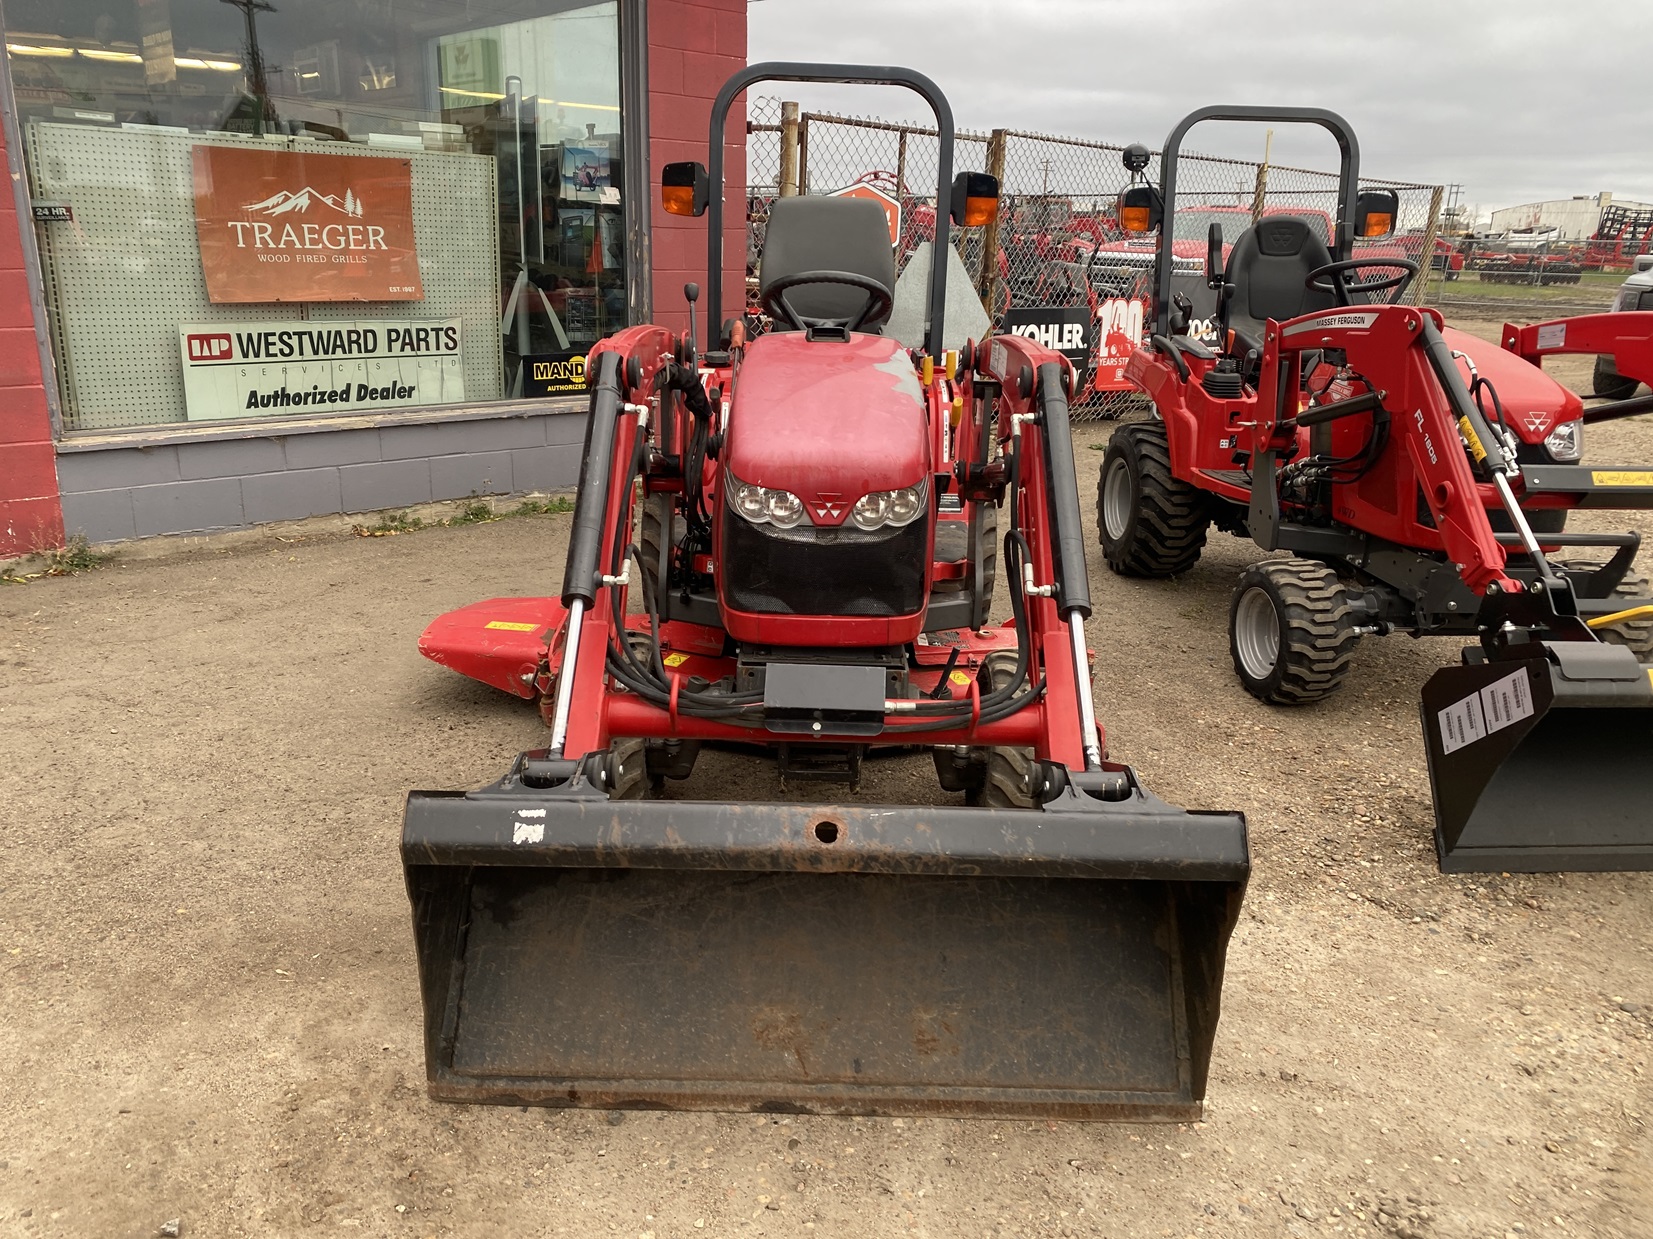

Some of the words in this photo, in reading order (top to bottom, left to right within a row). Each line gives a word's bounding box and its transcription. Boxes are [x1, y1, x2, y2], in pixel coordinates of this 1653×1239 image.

[35, 207, 50, 216] 24
[51, 207, 70, 216] HR.
[227, 221, 388, 250] TRAEGER
[257, 254, 291, 263] WOOD
[295, 254, 327, 263] FIRED
[331, 255, 368, 264] GRILLS
[1097, 299, 1142, 357] 100
[1316, 317, 1337, 327] MASSEY
[1337, 316, 1365, 325] FERGUSON
[236, 329, 378, 359] WESTWARD
[387, 326, 459, 353] PARTS
[240, 362, 381, 377] SERVICES
[417, 359, 457, 369] LTD
[1099, 357, 1118, 366] YEARS
[1118, 357, 1131, 366] STR
[534, 362, 584, 380] MAND
[245, 383, 351, 409] Authorized
[356, 380, 416, 402] Dealer
[1414, 408, 1425, 433] FL
